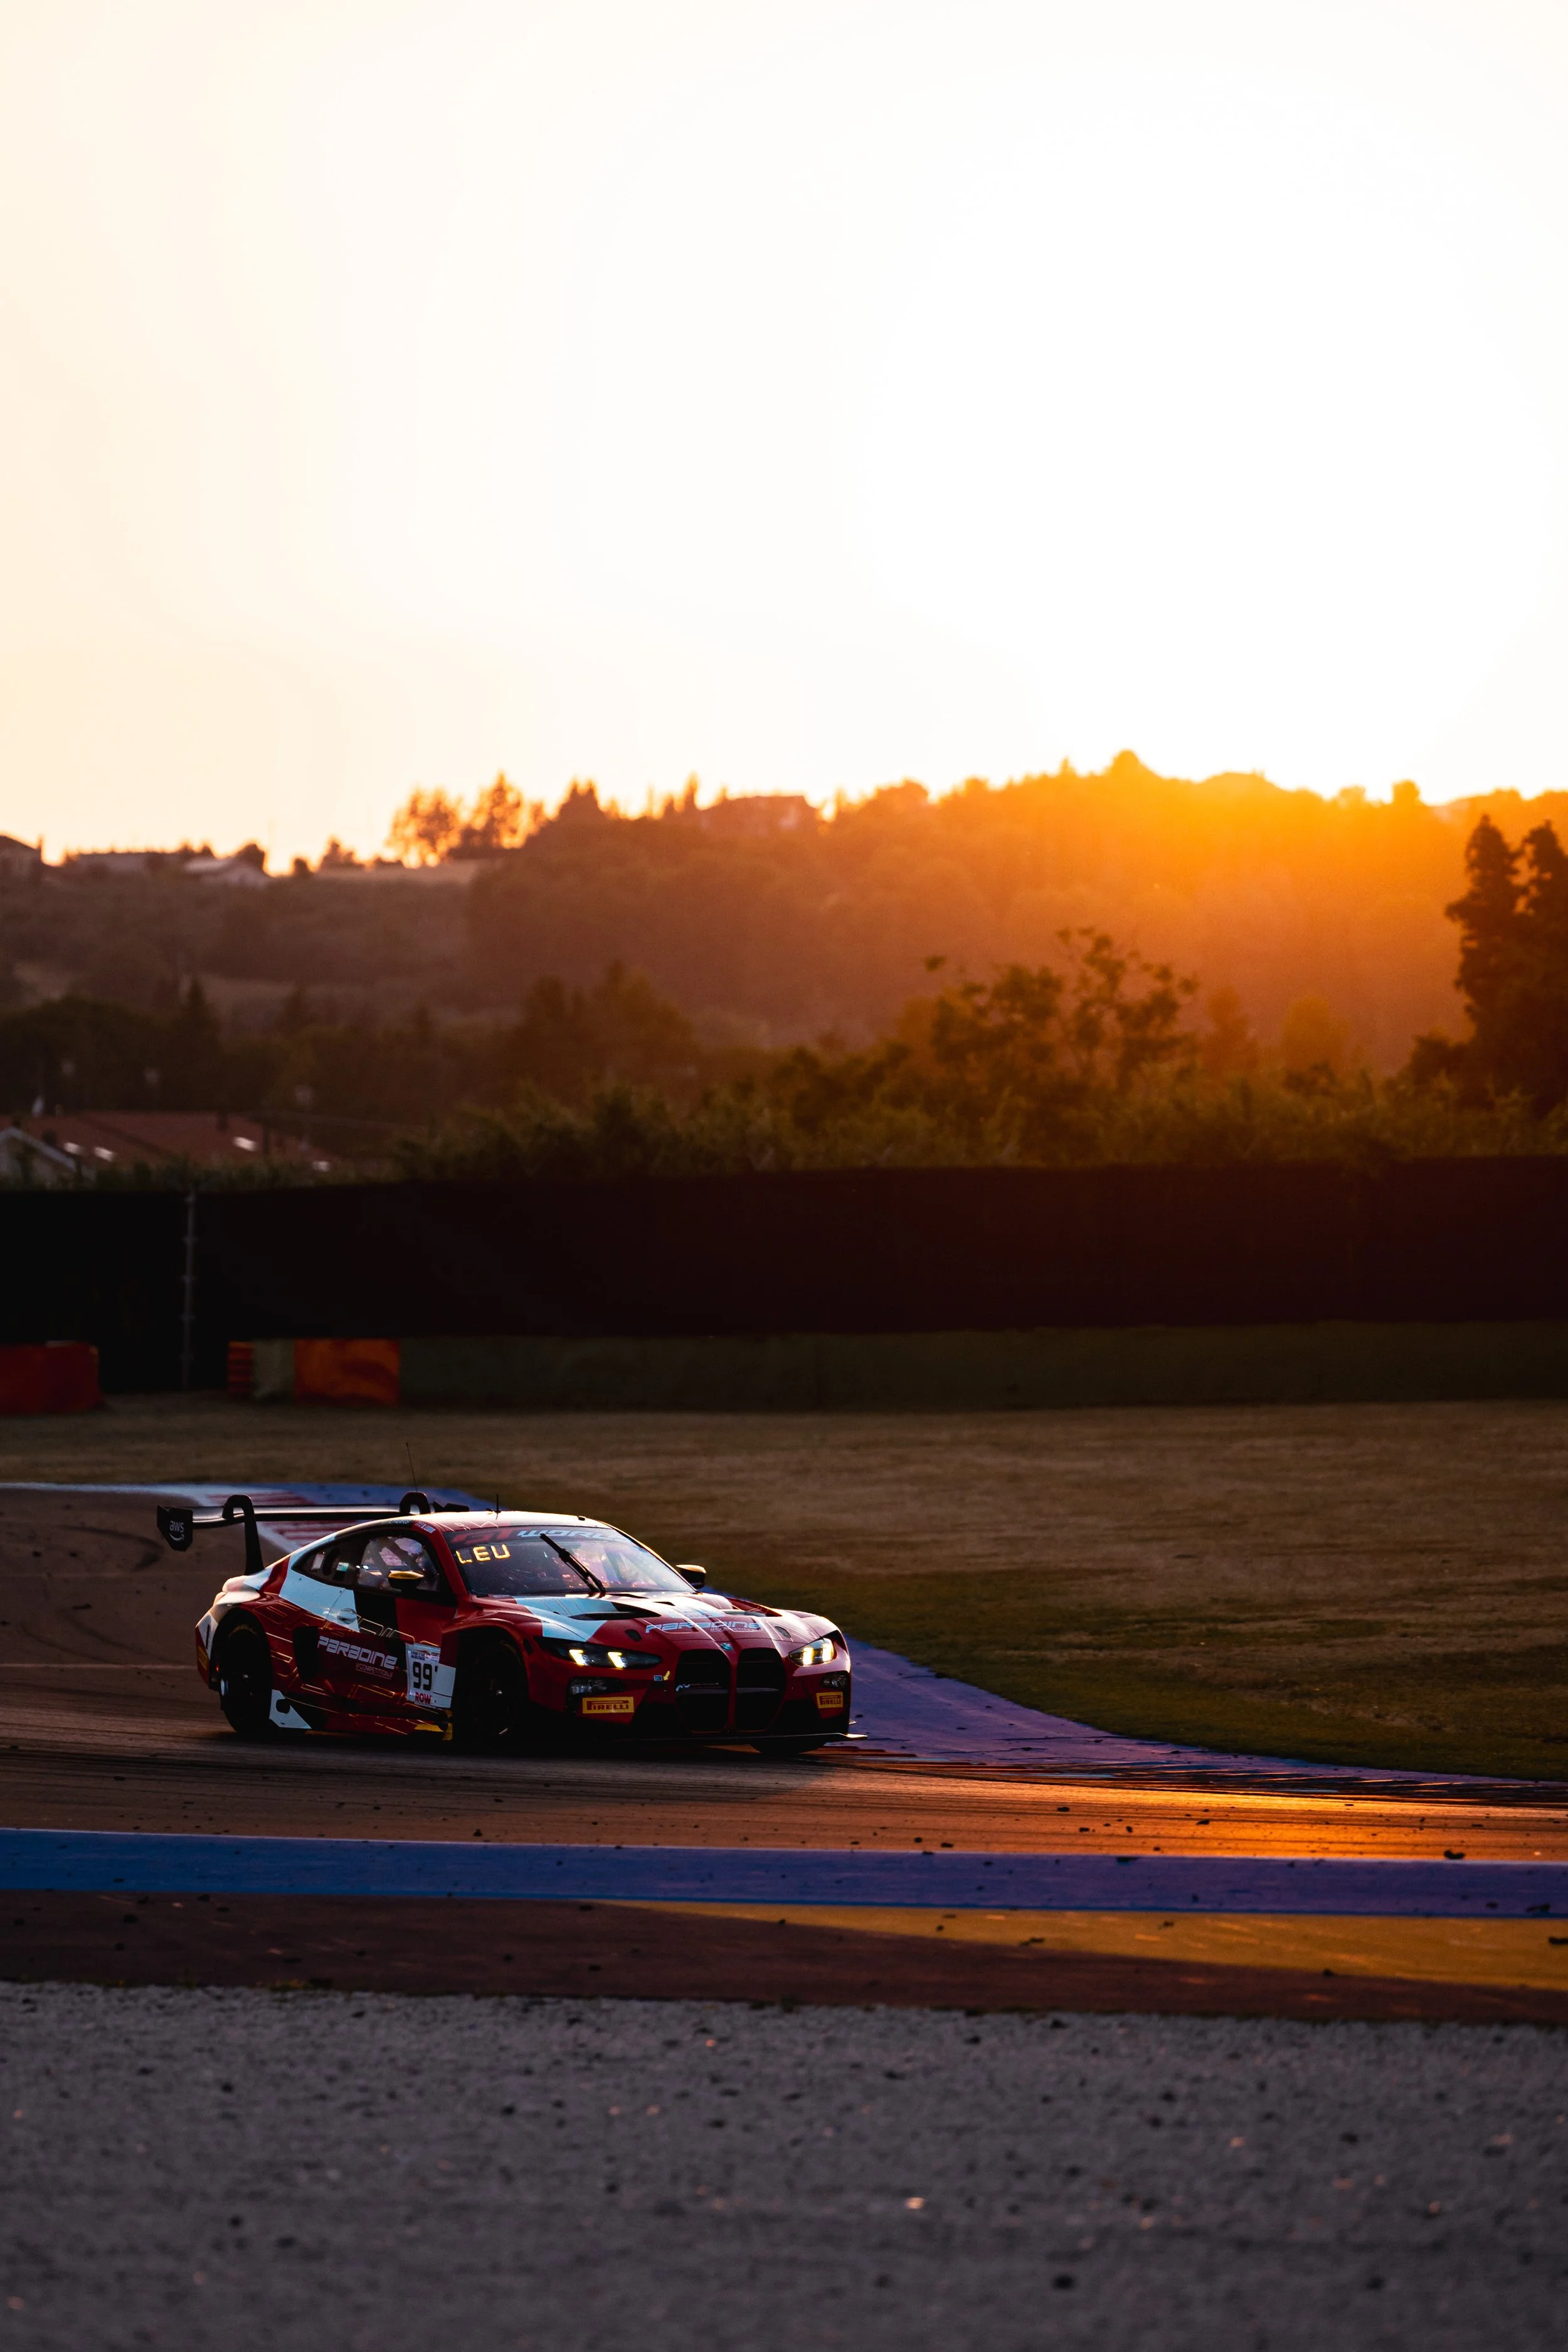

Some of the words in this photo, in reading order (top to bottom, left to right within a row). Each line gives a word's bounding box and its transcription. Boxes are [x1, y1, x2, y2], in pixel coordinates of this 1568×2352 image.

[169, 1520, 184, 1533] aws
[455, 1544, 511, 1565] LEU
[415, 1692, 432, 1704] ROW
[820, 1695, 842, 1705] PIRELLI
[586, 1700, 629, 1710] PIRELLI
